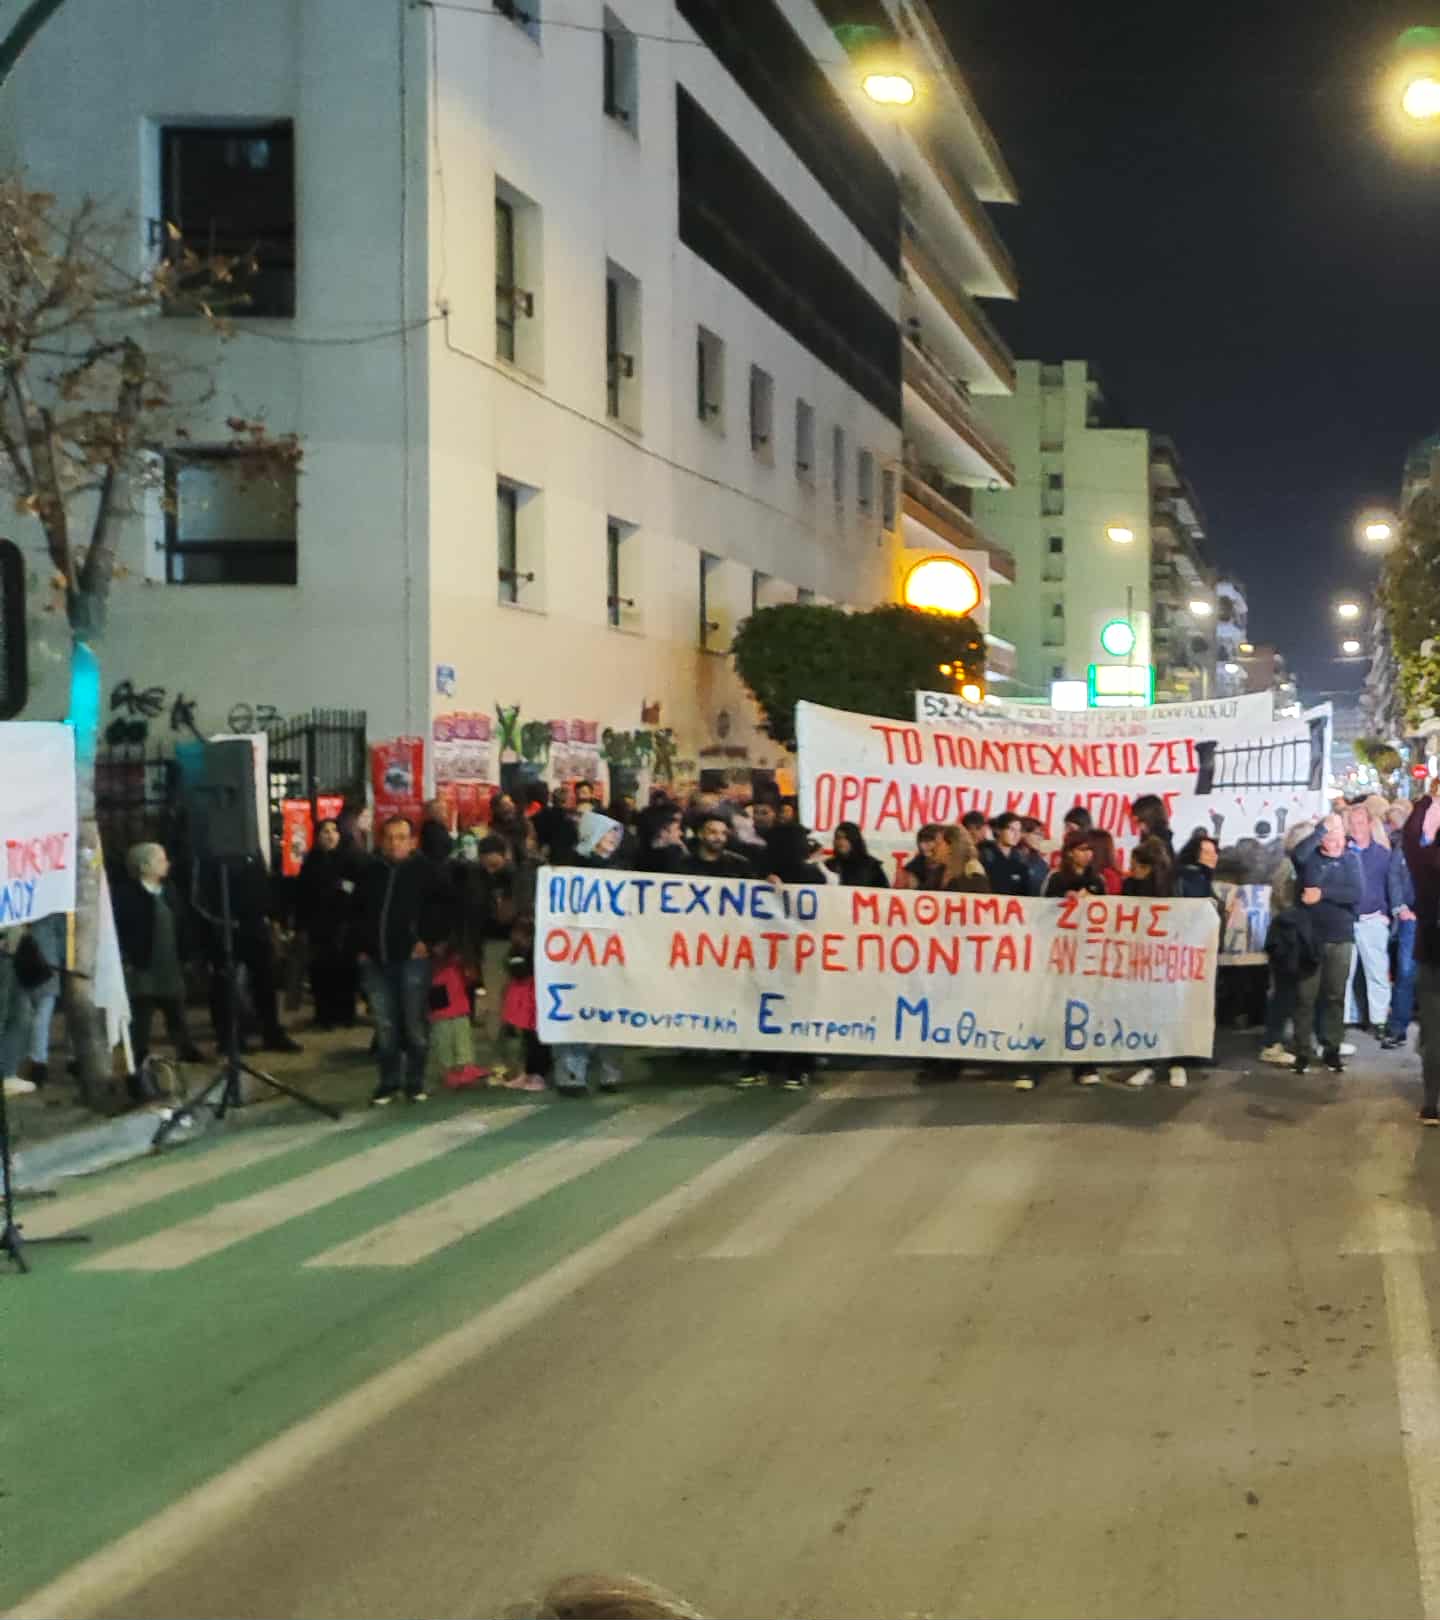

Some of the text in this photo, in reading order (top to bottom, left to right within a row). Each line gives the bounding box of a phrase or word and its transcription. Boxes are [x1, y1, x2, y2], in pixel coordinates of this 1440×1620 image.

[869, 724, 924, 766] ΤΟ
[933, 733, 1140, 778] ΠΟΛΥΤΕΧΝΕΙΟ
[1144, 738, 1200, 776] ΖΕΙ
[549, 876, 818, 920] ΠΟΛΥΤΕΧΝΕΙΟ
[852, 890, 1025, 927] ΜΑΘΗΜΑ
[543, 928, 627, 967] ΟΛΑ
[669, 931, 1033, 976] ΑΝΑΤΡΕΠΟΝΤΑΙ
[895, 995, 1047, 1051] Μαθητών
